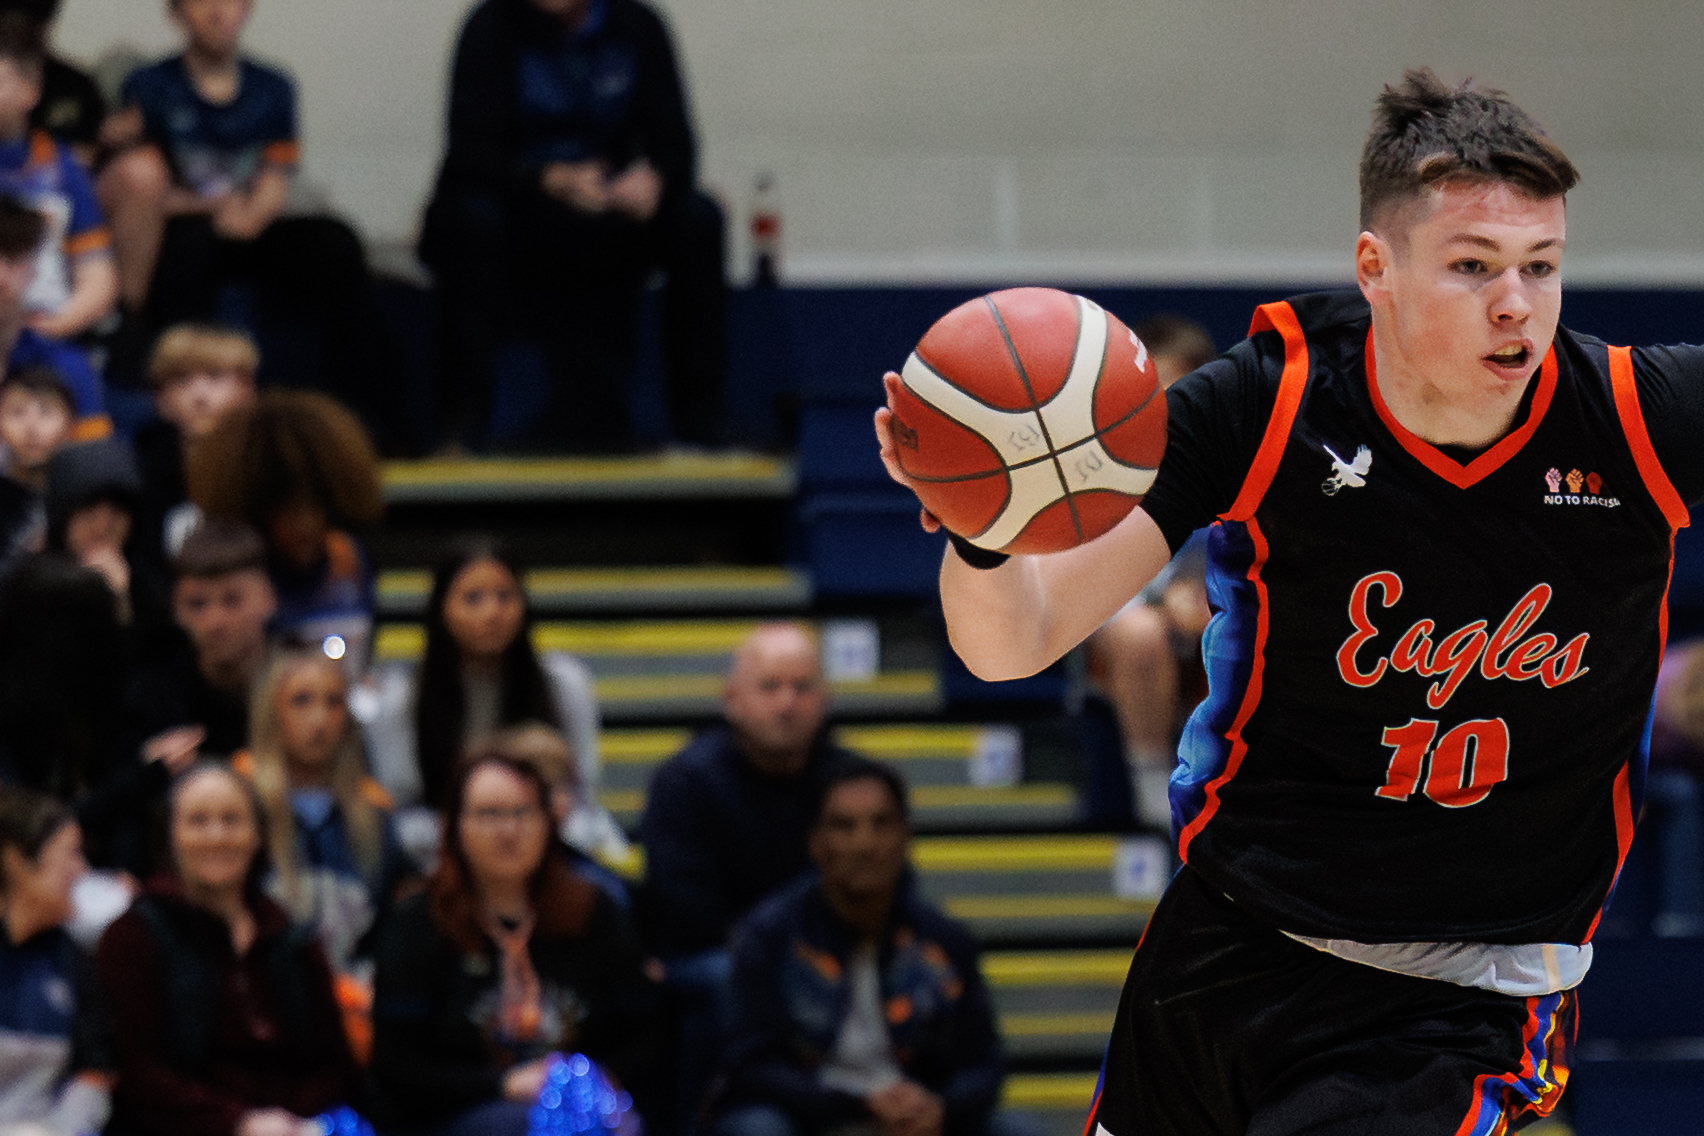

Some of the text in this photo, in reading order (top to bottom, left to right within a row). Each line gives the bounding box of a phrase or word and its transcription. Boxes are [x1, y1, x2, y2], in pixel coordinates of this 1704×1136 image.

[1544, 495, 1563, 505] NO
[1565, 495, 1580, 505] TO
[1337, 570, 1590, 709] Eagles
[1374, 717, 1510, 808] 10
